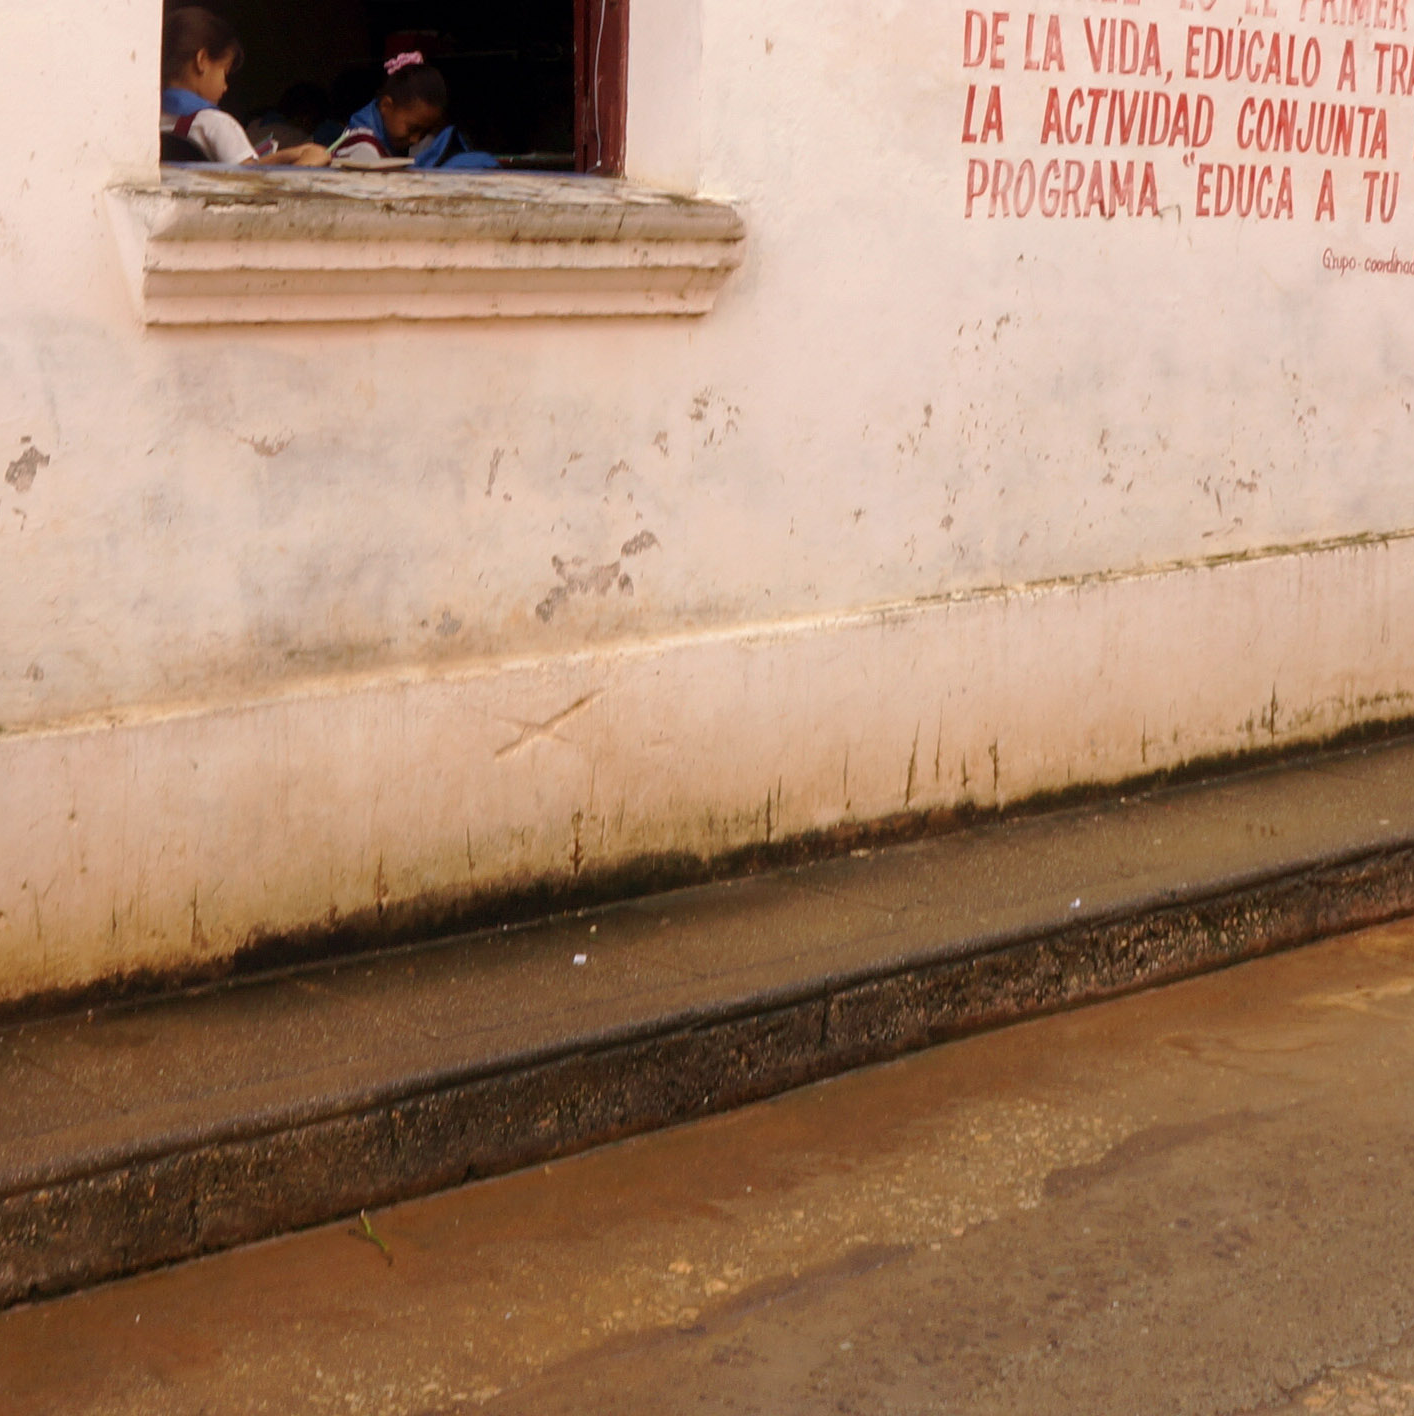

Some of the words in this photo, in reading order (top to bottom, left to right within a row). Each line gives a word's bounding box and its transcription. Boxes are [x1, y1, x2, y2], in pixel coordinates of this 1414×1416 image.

[963, 9, 1010, 70] DE
[1024, 13, 1065, 72] LA
[1083, 17, 1173, 84] VIDA,
[1185, 17, 1322, 88] EDÚCALO
[1336, 39, 1356, 92] A
[961, 84, 1004, 144] LA
[1040, 87, 1215, 148] ACTIVIDAD
[1237, 97, 1388, 160] CONJUNTA
[964, 158, 1160, 219] PROGRAMA
[1314, 169, 1335, 222] A
[1363, 170, 1400, 224] TU
[1322, 247, 1357, 277] Grupo
